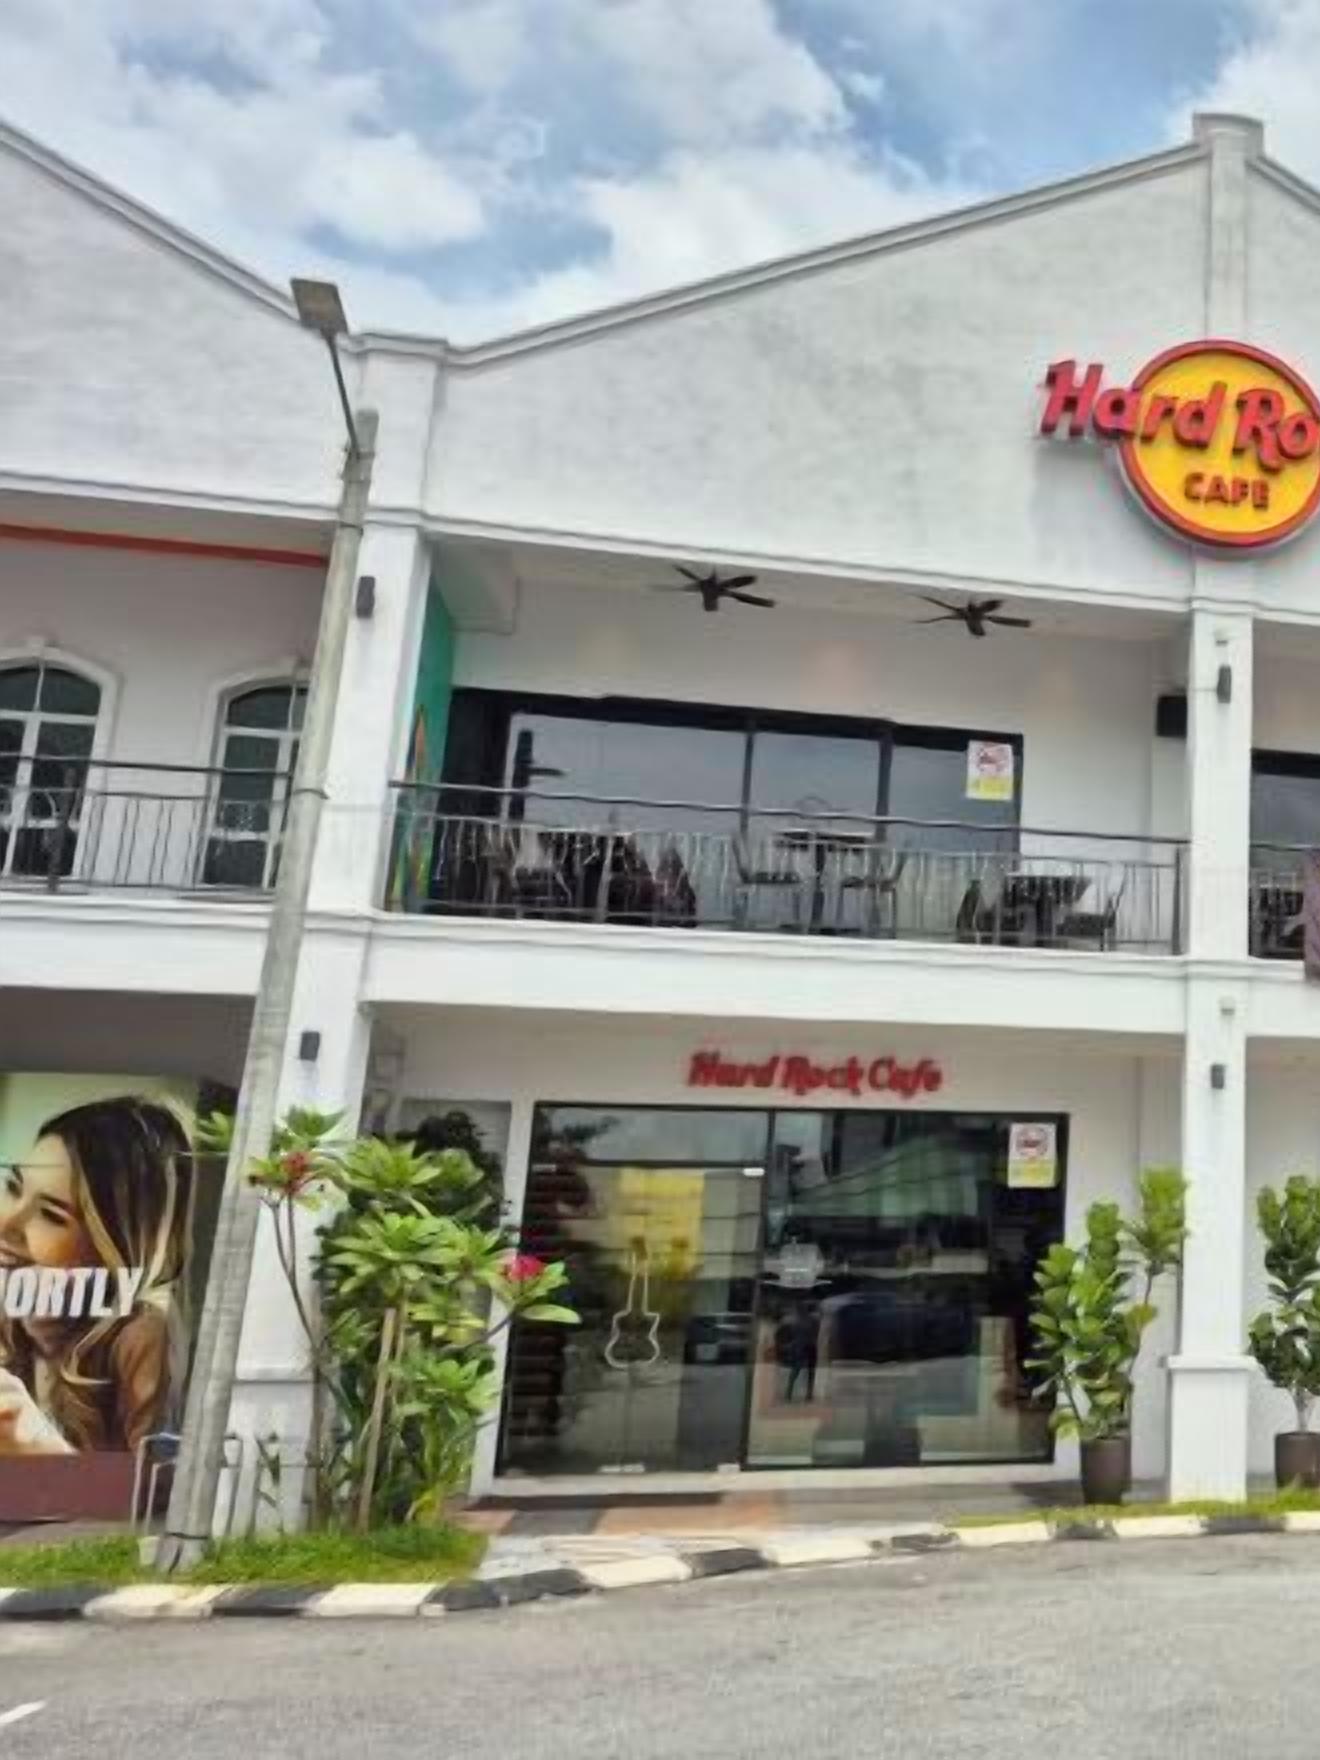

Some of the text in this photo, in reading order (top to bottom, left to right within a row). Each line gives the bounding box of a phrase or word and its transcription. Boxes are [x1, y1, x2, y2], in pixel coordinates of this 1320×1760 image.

[1040, 360, 1229, 450] Hard
[1184, 471, 1271, 510] CAFE
[689, 1052, 942, 1098] Hard Rock Cafe
[0, 1266, 143, 1318] ORTLY
